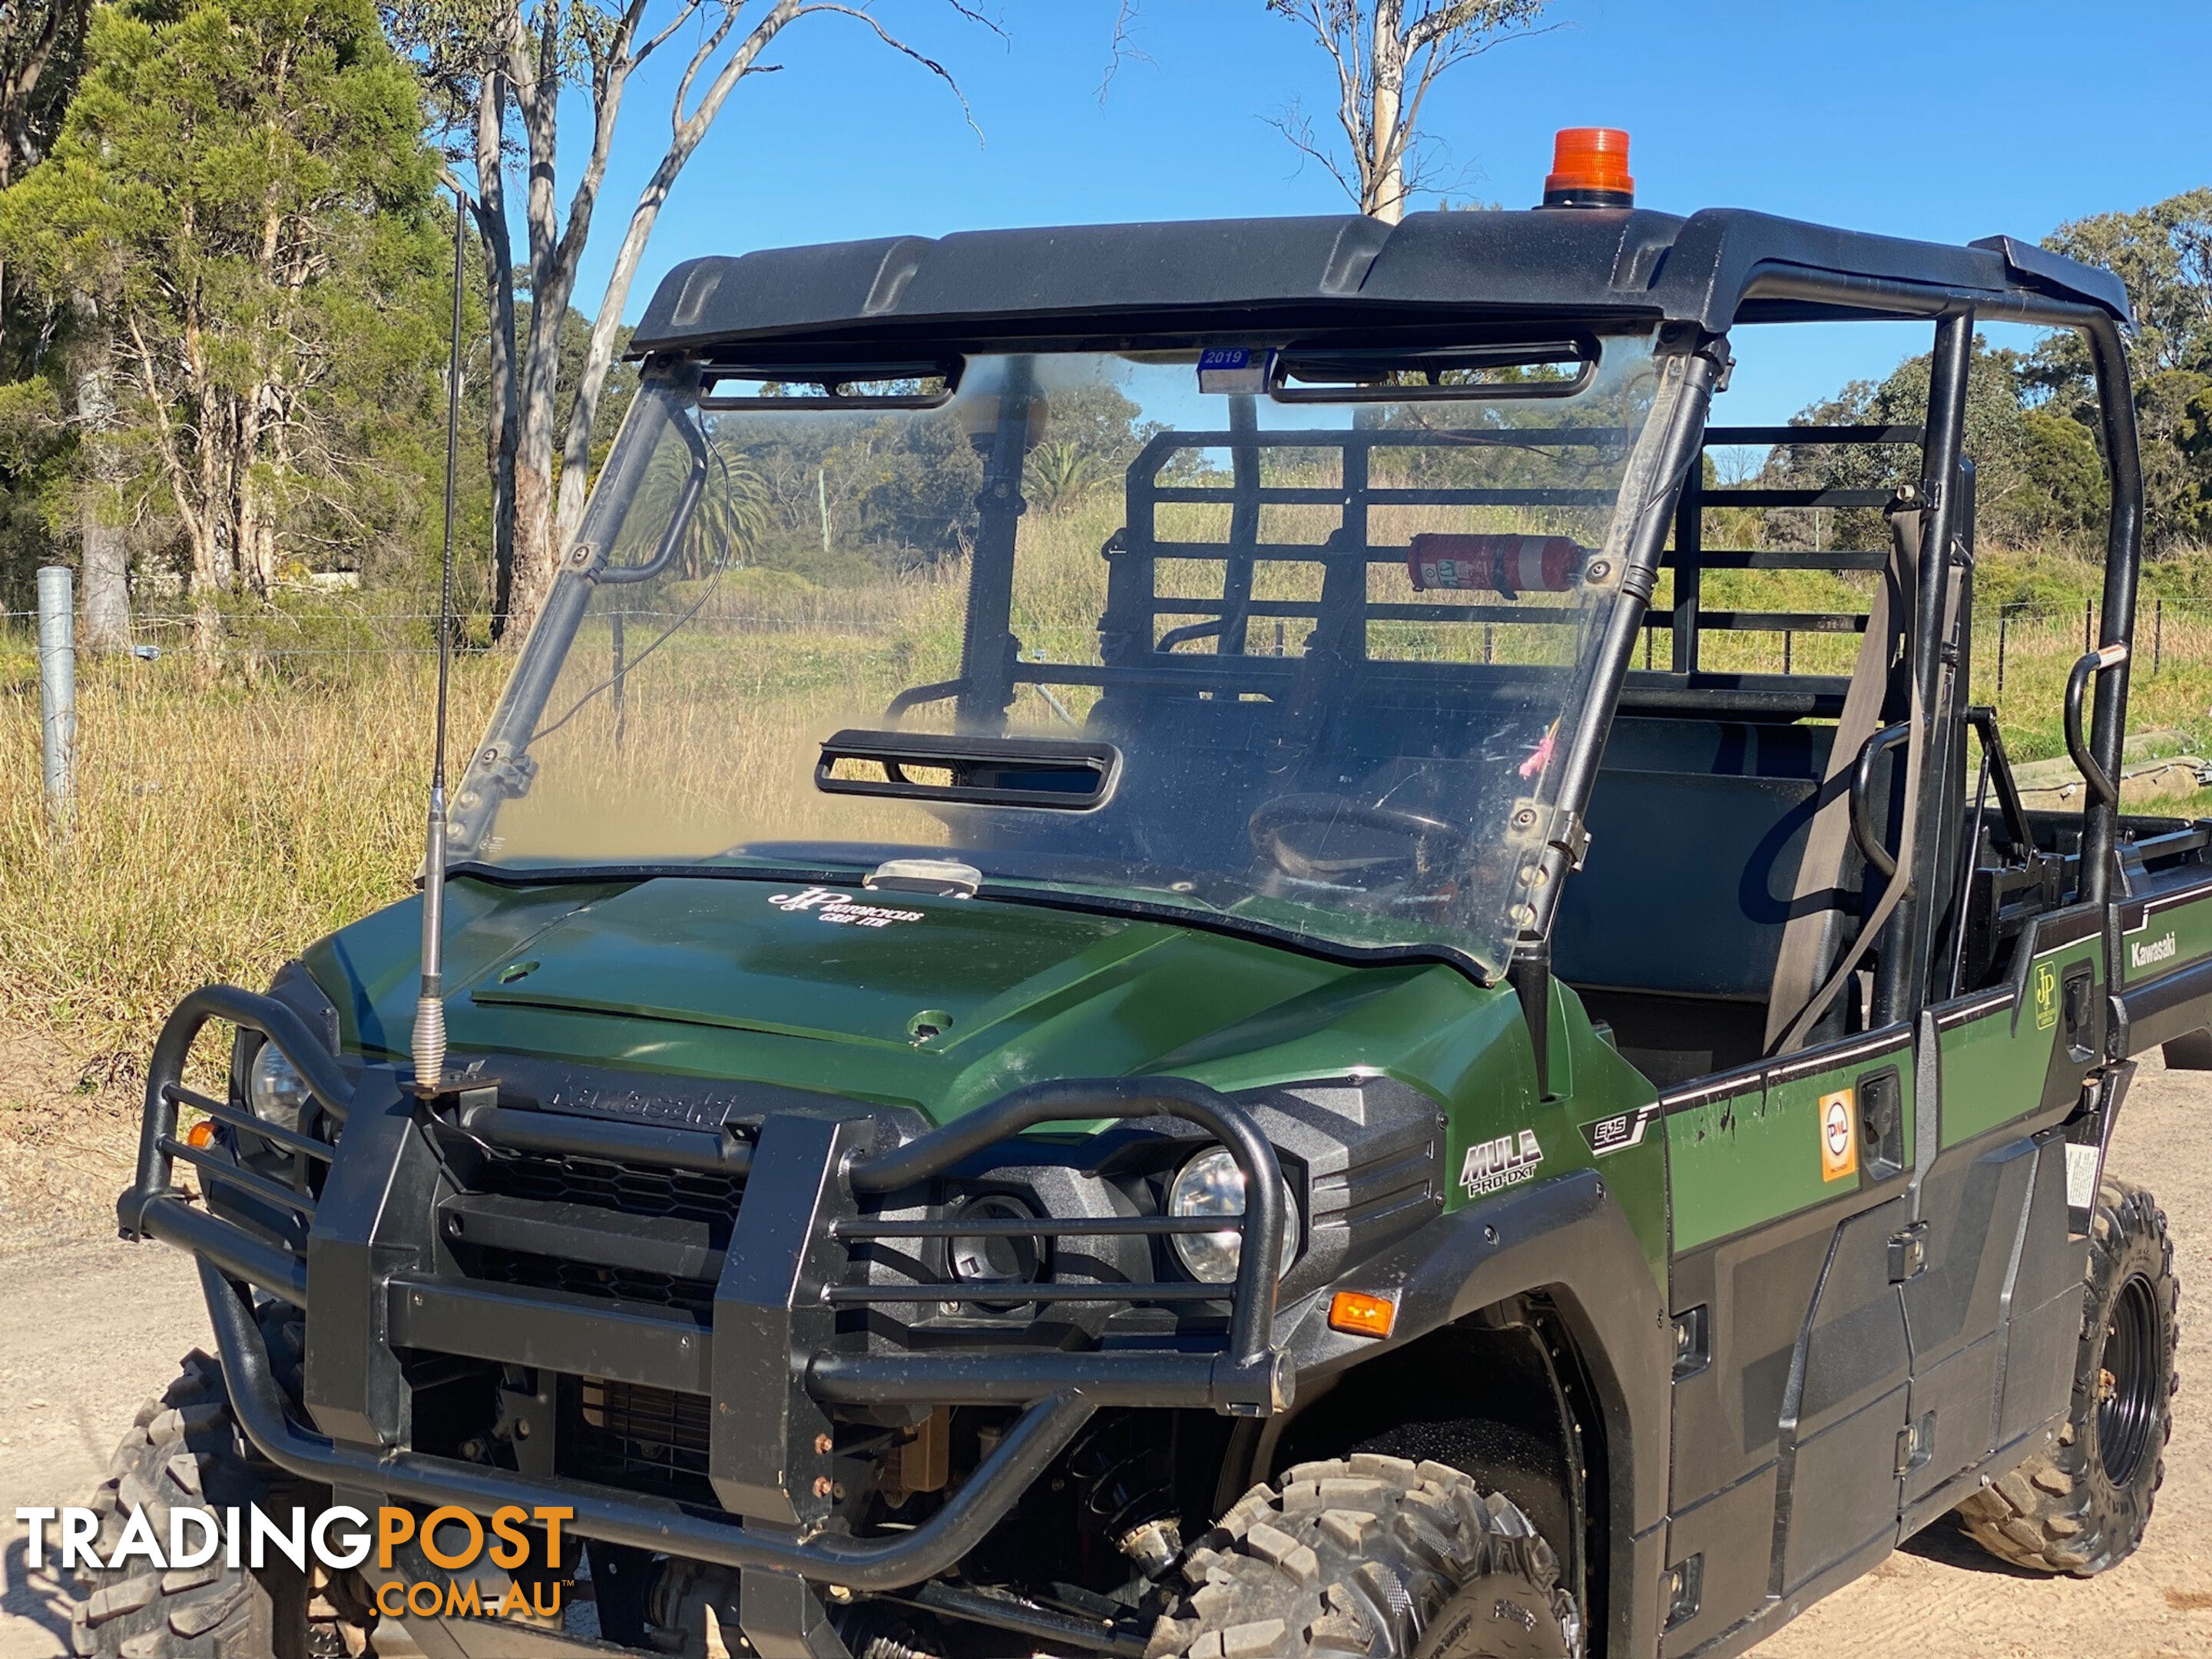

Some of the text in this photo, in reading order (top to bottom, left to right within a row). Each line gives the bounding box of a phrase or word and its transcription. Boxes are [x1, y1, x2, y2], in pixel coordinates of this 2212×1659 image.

[1205, 351, 1242, 363] 2019
[820, 902, 926, 922] MOTORCYCLES
[2131, 931, 2176, 968] Kawasaki
[1594, 1116, 1627, 1141] EPS
[1459, 1129, 1544, 1186] MULE
